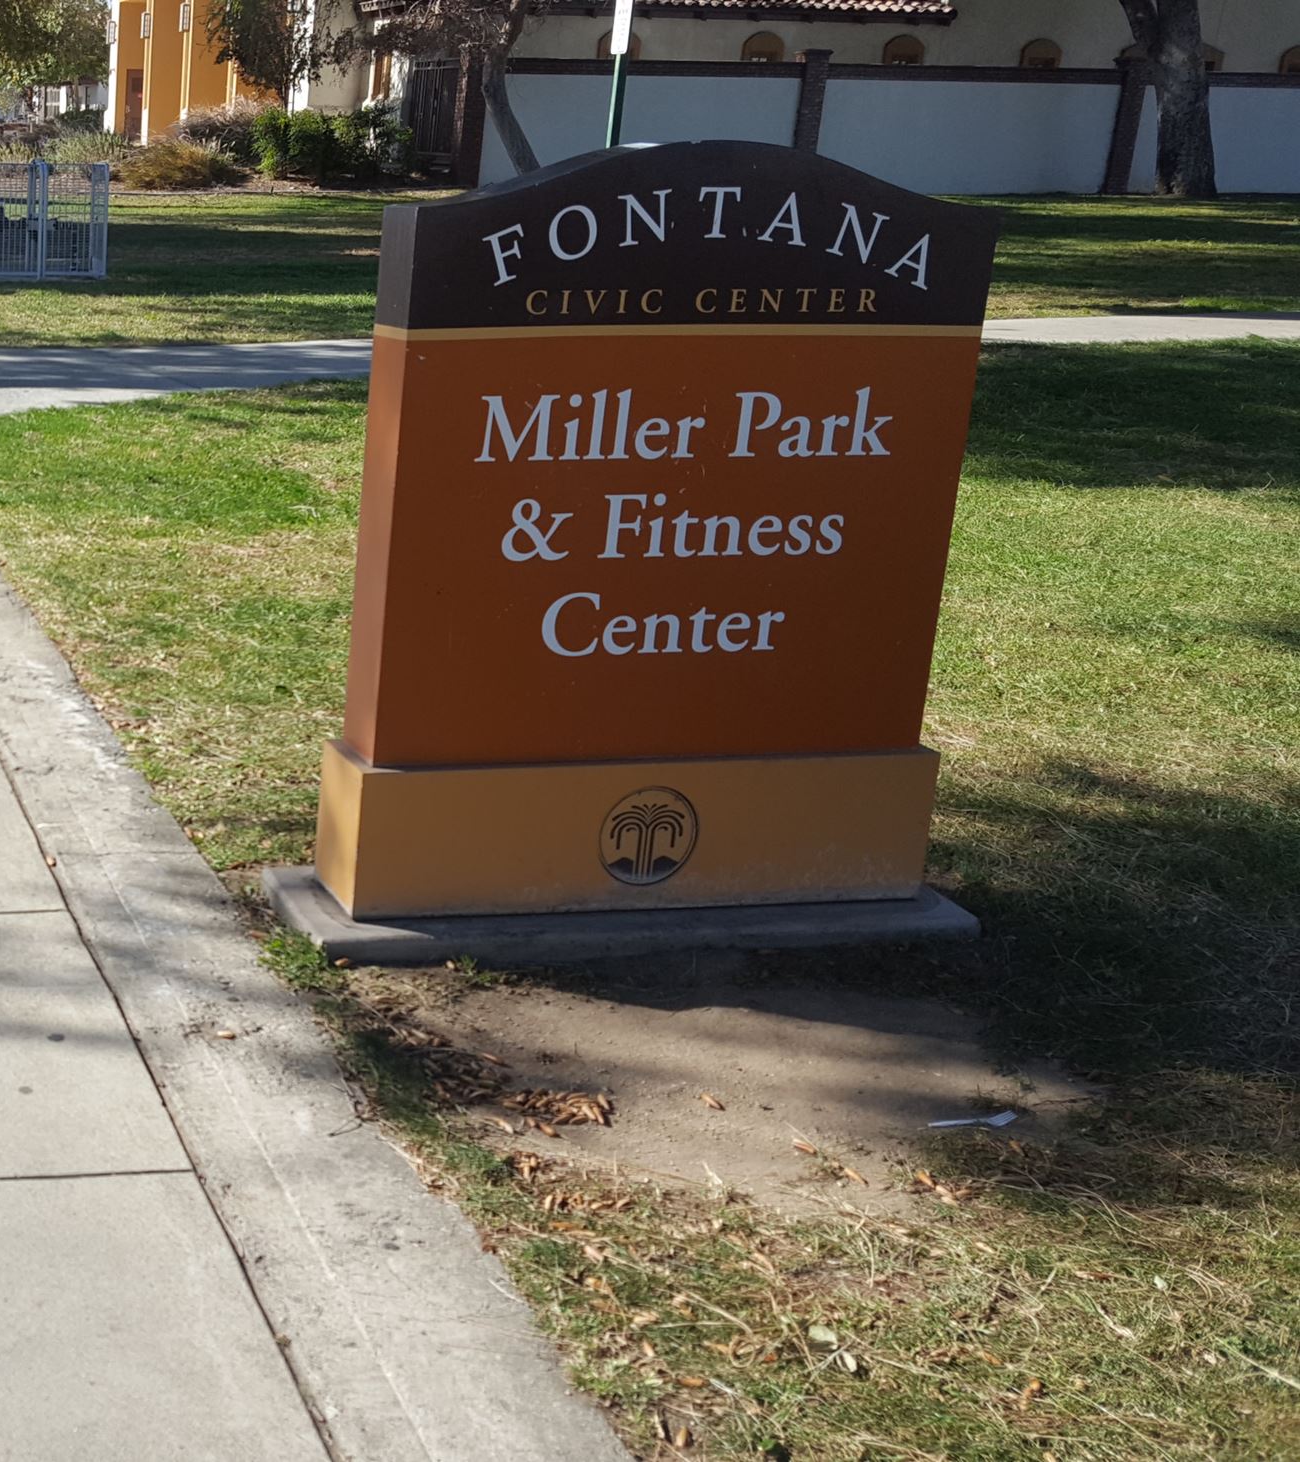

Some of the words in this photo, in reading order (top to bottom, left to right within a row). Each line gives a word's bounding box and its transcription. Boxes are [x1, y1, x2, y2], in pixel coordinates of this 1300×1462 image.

[482, 186, 931, 291] FONTANA
[526, 289, 664, 315] CIVIC
[695, 287, 878, 314] CENTER
[474, 388, 706, 462] Miller
[728, 386, 894, 458] Park
[501, 498, 574, 562] &
[597, 493, 845, 559] Fitness
[541, 592, 786, 657] Center
